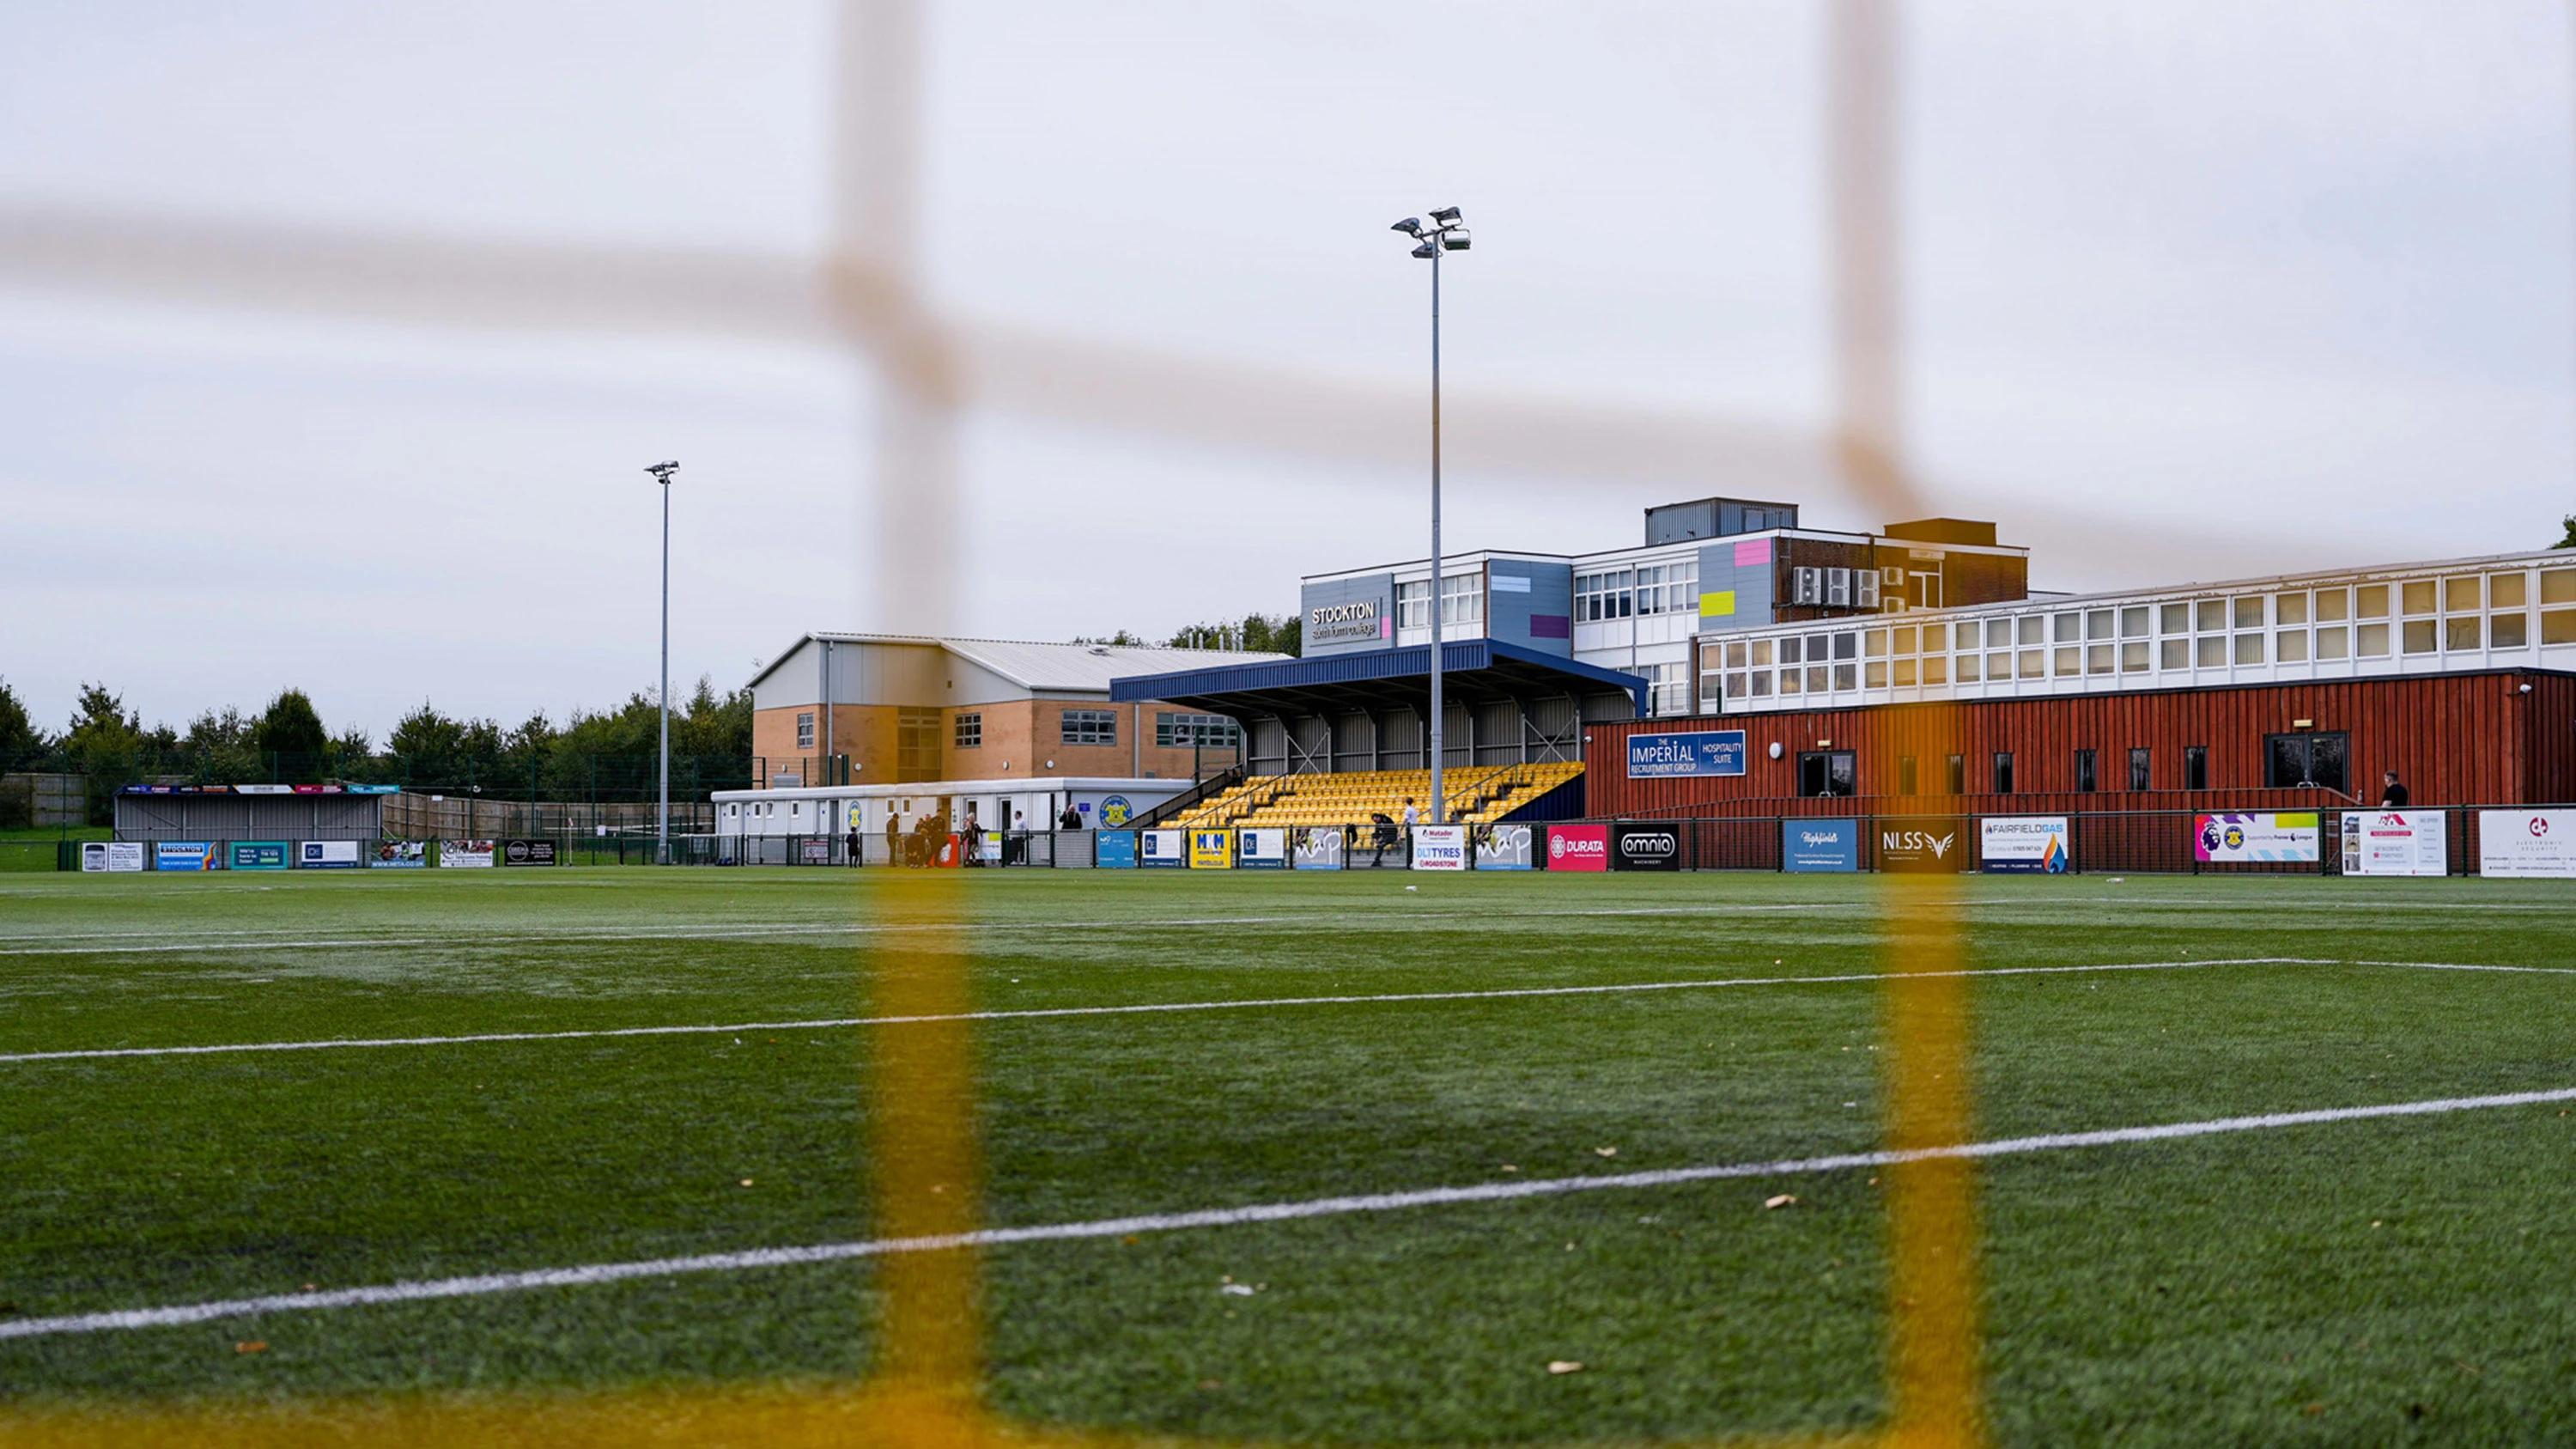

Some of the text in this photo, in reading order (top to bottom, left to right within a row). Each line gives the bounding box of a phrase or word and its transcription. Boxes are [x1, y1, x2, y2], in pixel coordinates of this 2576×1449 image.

[1312, 602, 1375, 624] STOCKTON
[1702, 743, 1742, 753] HOSPITALITY
[1713, 754, 1731, 764] SUITE
[1631, 763, 1696, 775] RECRUITMENT GROUP
[1197, 834, 1224, 849] MKM
[1567, 840, 1604, 852] DURATA
[1625, 839, 1670, 852] omnia
